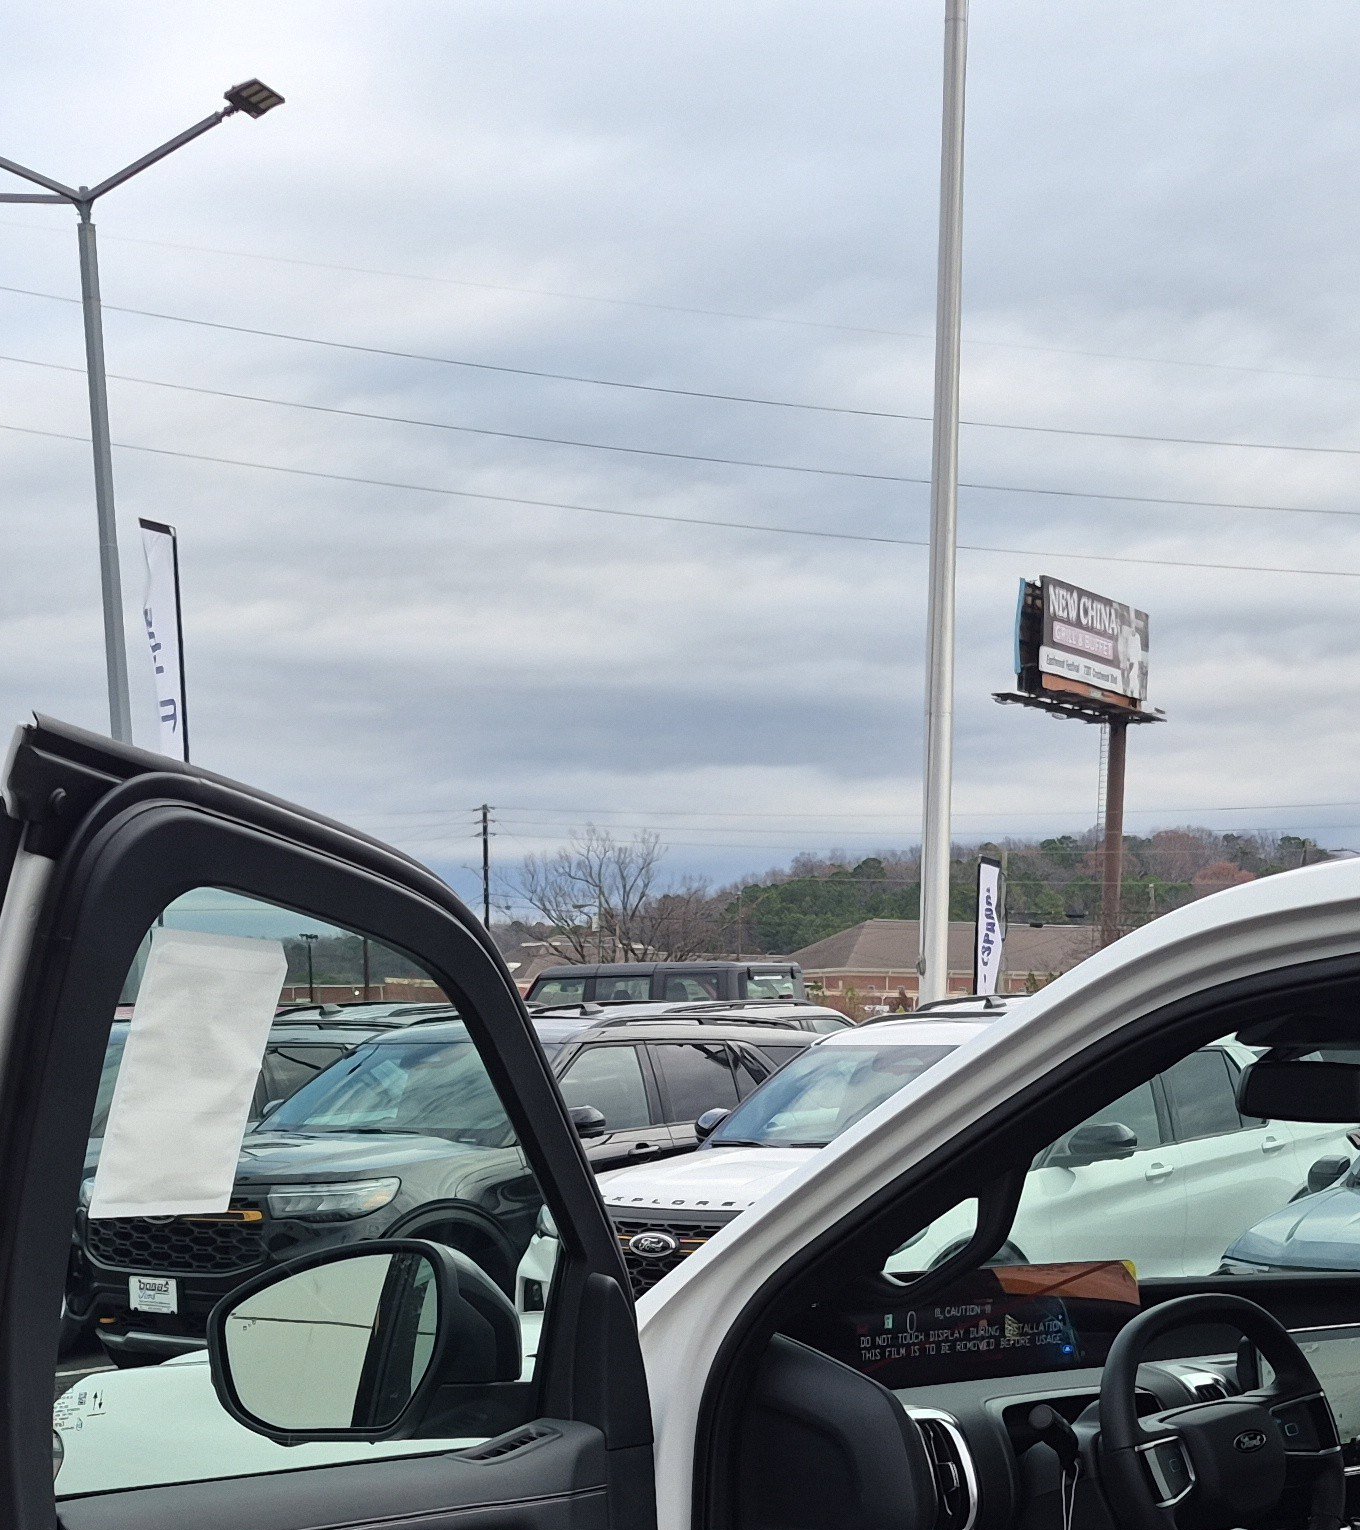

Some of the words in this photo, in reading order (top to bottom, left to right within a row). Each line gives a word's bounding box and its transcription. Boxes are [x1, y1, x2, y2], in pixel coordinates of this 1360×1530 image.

[1049, 584, 1078, 622] NEW
[1080, 596, 1117, 636] CHINA
[945, 1305, 980, 1317] CAUTION
[860, 1337, 871, 1347] DO
[876, 1335, 892, 1345] NOT
[898, 1332, 925, 1343] TOUCH
[929, 1329, 965, 1341] DISPLAY
[970, 1326, 1000, 1338] DURING
[861, 1349, 880, 1360] THIS
[886, 1347, 906, 1359] FILM
[911, 1346, 920, 1356] IS
[925, 1344, 936, 1355] TO
[956, 1339, 995, 1351] REMOVED
[1000, 1336, 1031, 1348] BEFORE
[1036, 1334, 1062, 1345] USAGE
